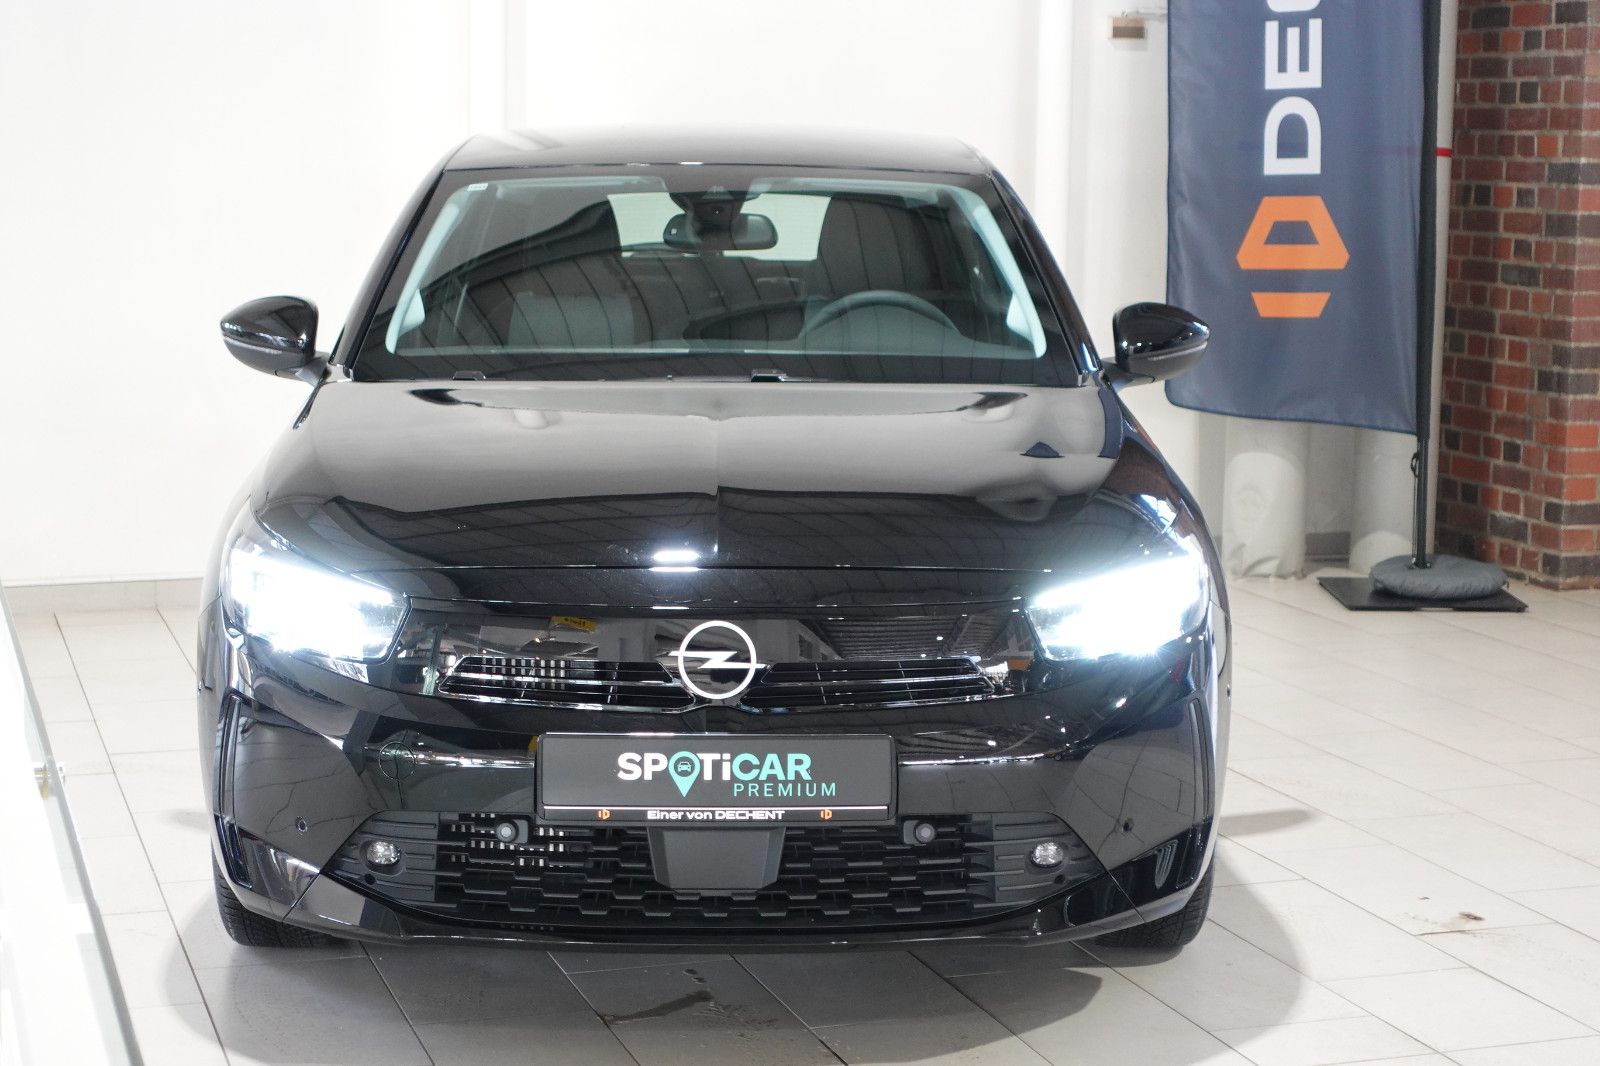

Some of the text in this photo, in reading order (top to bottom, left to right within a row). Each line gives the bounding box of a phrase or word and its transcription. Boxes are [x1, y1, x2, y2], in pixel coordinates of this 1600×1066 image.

[1263, 0, 1323, 176] DE
[733, 783, 837, 797] PREMIUM
[647, 810, 786, 820] Einer von DECHENT
